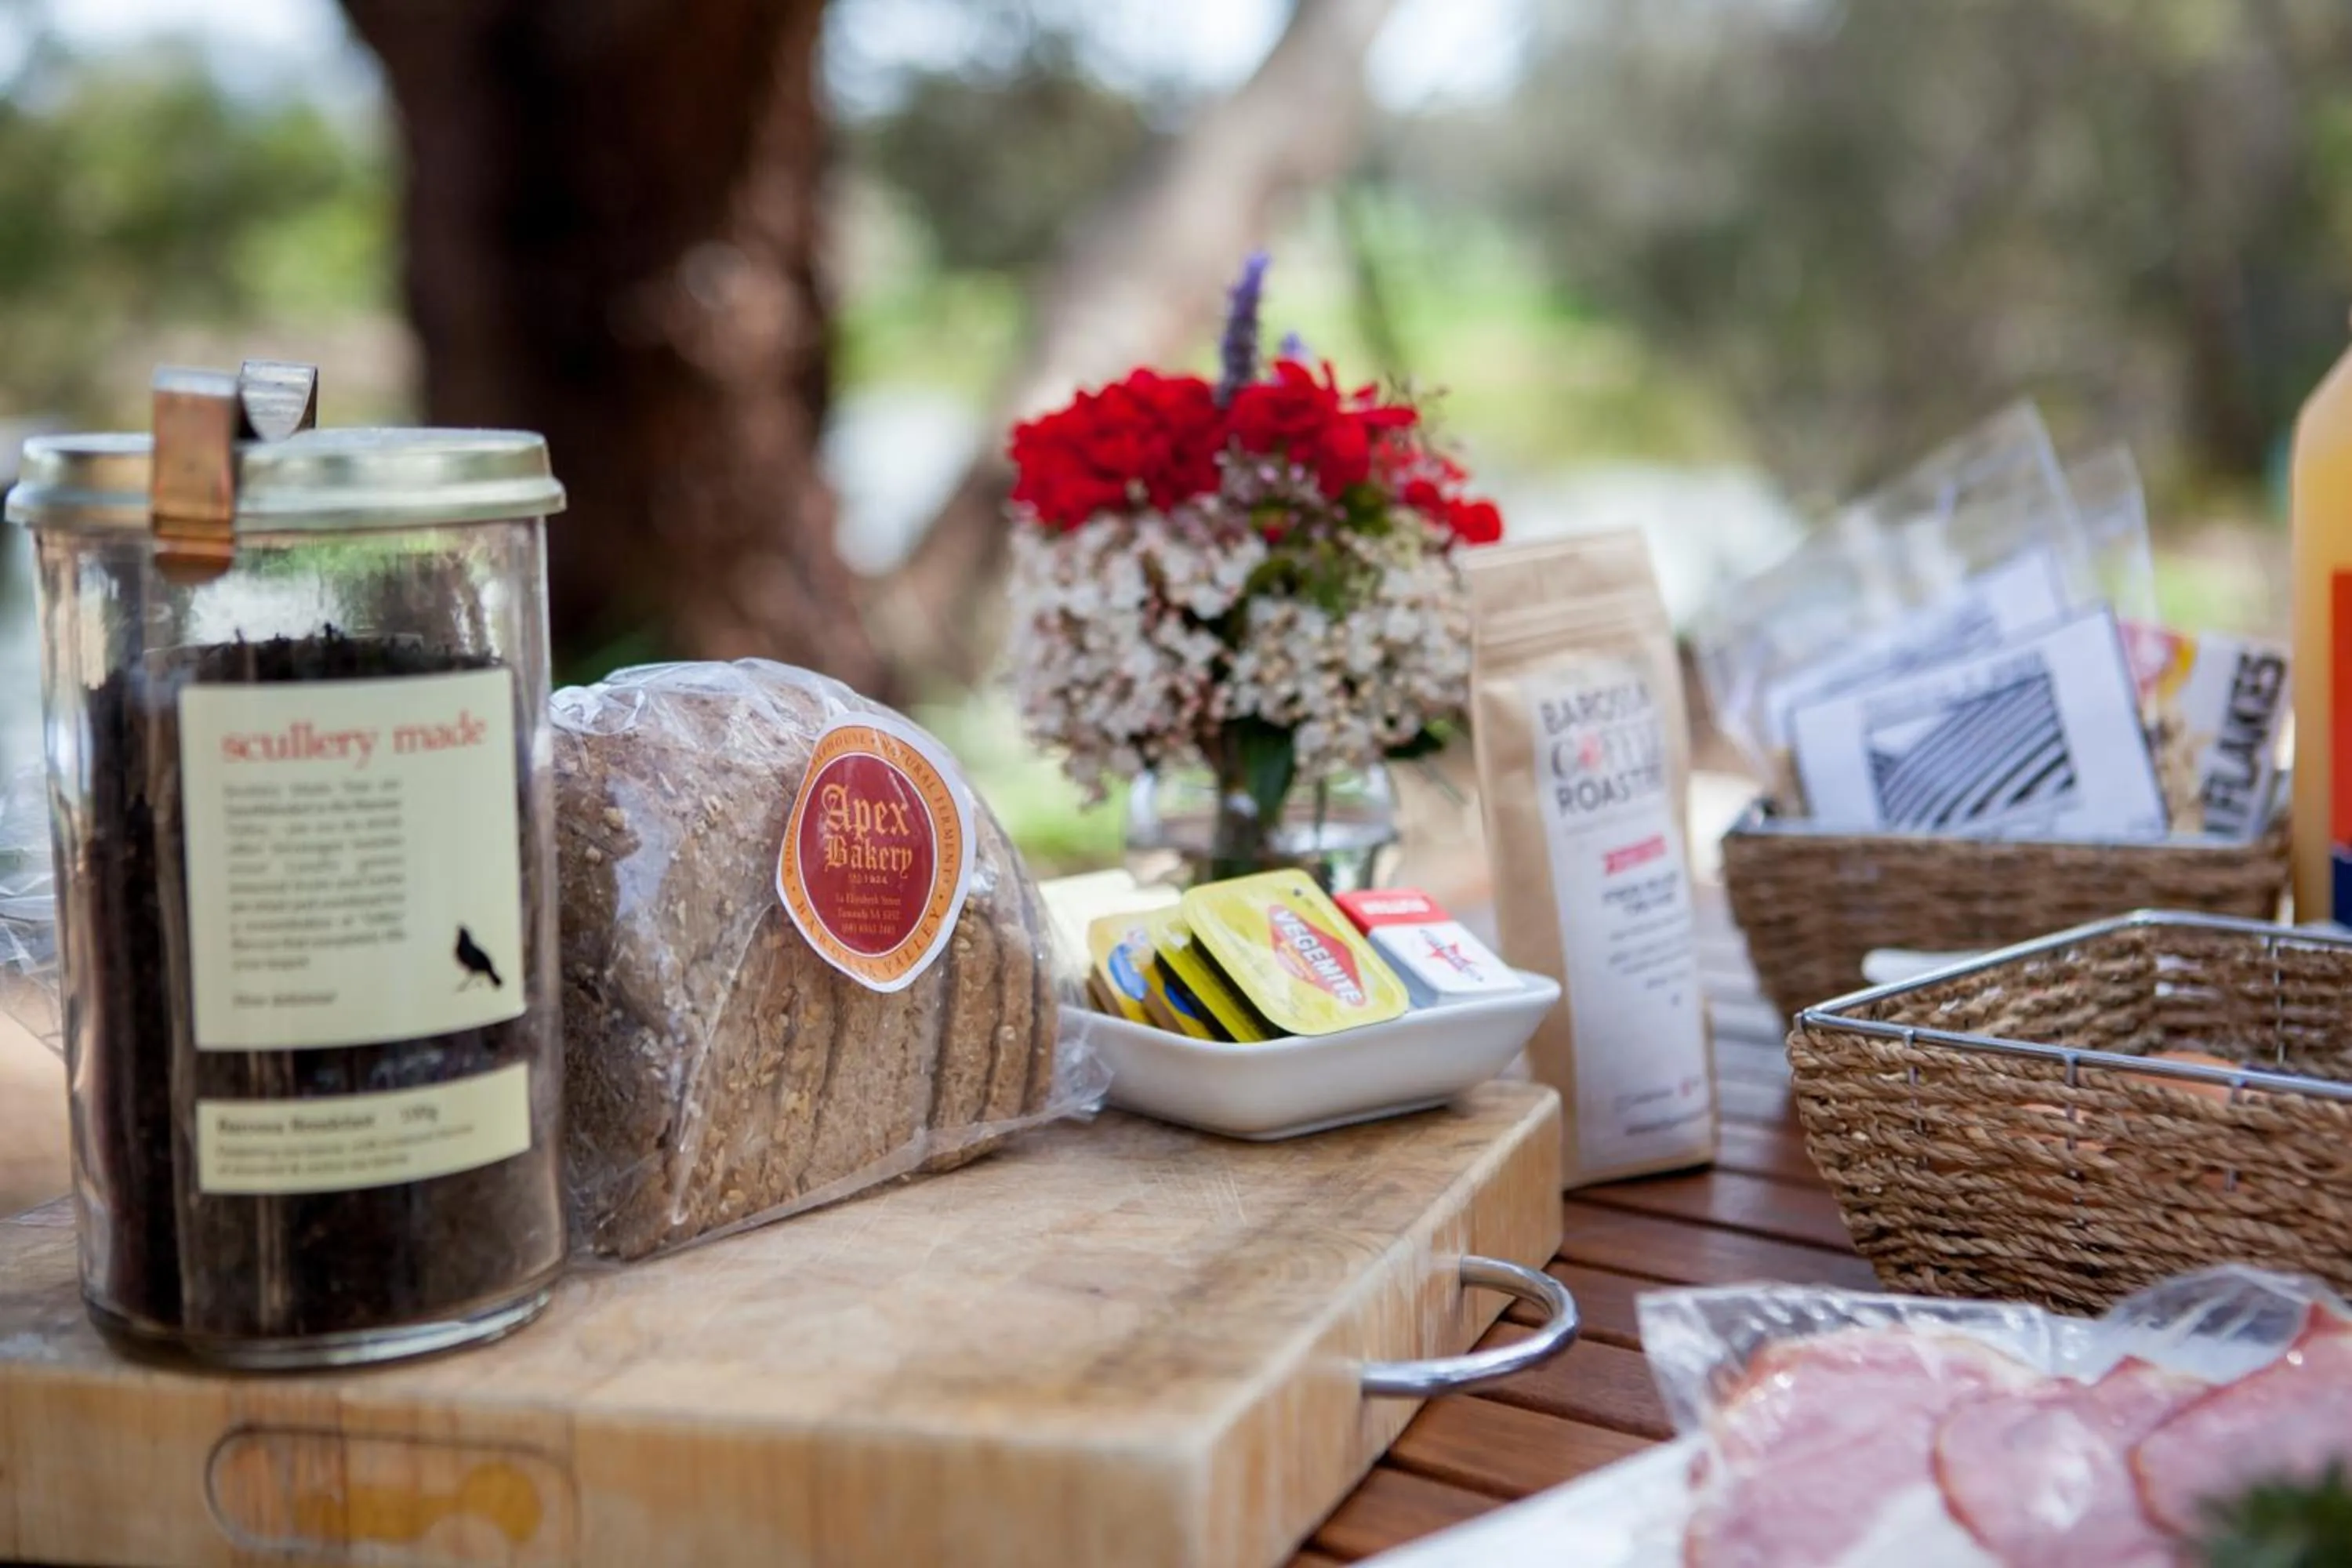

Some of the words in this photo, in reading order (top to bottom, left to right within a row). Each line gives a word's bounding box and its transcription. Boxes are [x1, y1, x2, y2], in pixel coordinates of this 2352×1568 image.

[221, 720, 378, 769] scullery
[394, 710, 487, 754] made
[820, 784, 909, 842] Apex
[823, 835, 913, 879] Bakery
